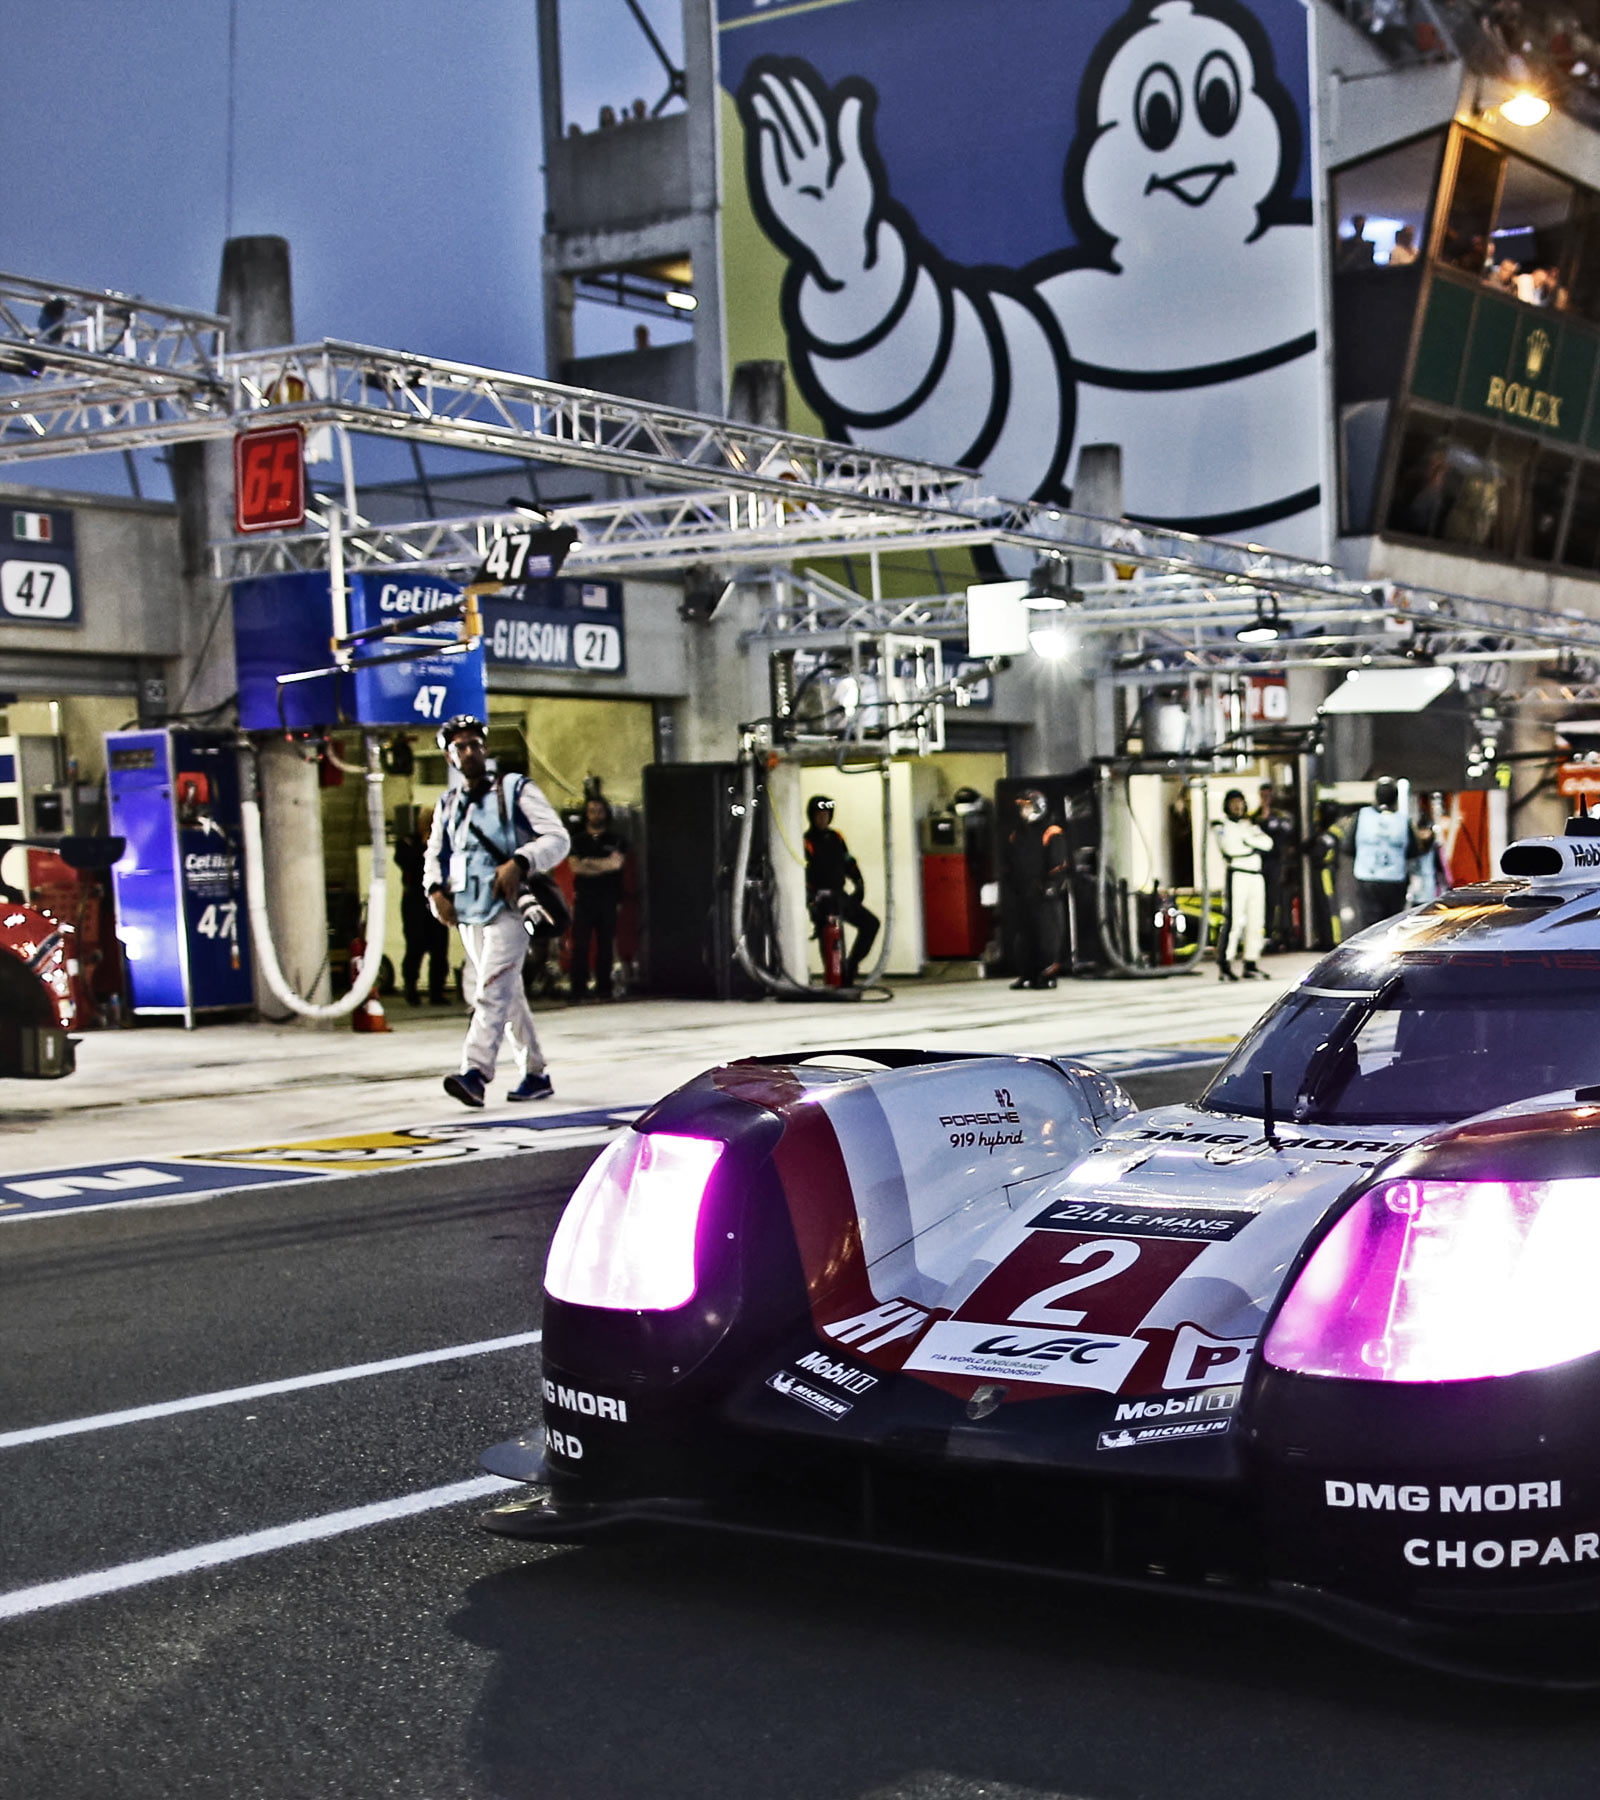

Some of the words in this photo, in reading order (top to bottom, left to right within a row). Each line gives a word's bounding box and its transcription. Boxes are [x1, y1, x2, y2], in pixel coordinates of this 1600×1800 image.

[1487, 375, 1563, 428] ROLEX
[243, 439, 299, 517] 65
[486, 533, 532, 580] 47
[16, 569, 56, 608] 47
[584, 630, 607, 662] 21
[413, 685, 447, 718] 47
[197, 902, 236, 939] 47
[994, 1088, 1015, 1108] #2
[939, 1111, 1020, 1128] PORSCHE
[950, 1132, 975, 1148] 919
[978, 1130, 1024, 1155] hybrid
[1131, 1130, 1248, 1145] DMG
[1108, 1214, 1149, 1225] LE
[1147, 1217, 1234, 1231] MANS
[1007, 1239, 1141, 1326] 2
[931, 1353, 947, 1361] FIA
[949, 1355, 984, 1364] WORLD
[984, 1358, 1049, 1371] ENDURANCE
[971, 1335, 1120, 1365] WEC
[795, 1351, 860, 1385] Mobil
[965, 1364, 1042, 1377] CHAMPIONSHIP
[557, 1384, 628, 1422] MORI
[793, 1385, 848, 1414] MICHELIN
[1114, 1395, 1204, 1421] Mobil
[1138, 1420, 1228, 1438] MICHELIN
[1325, 1480, 1429, 1511] DMG
[1439, 1480, 1562, 1512] MORI
